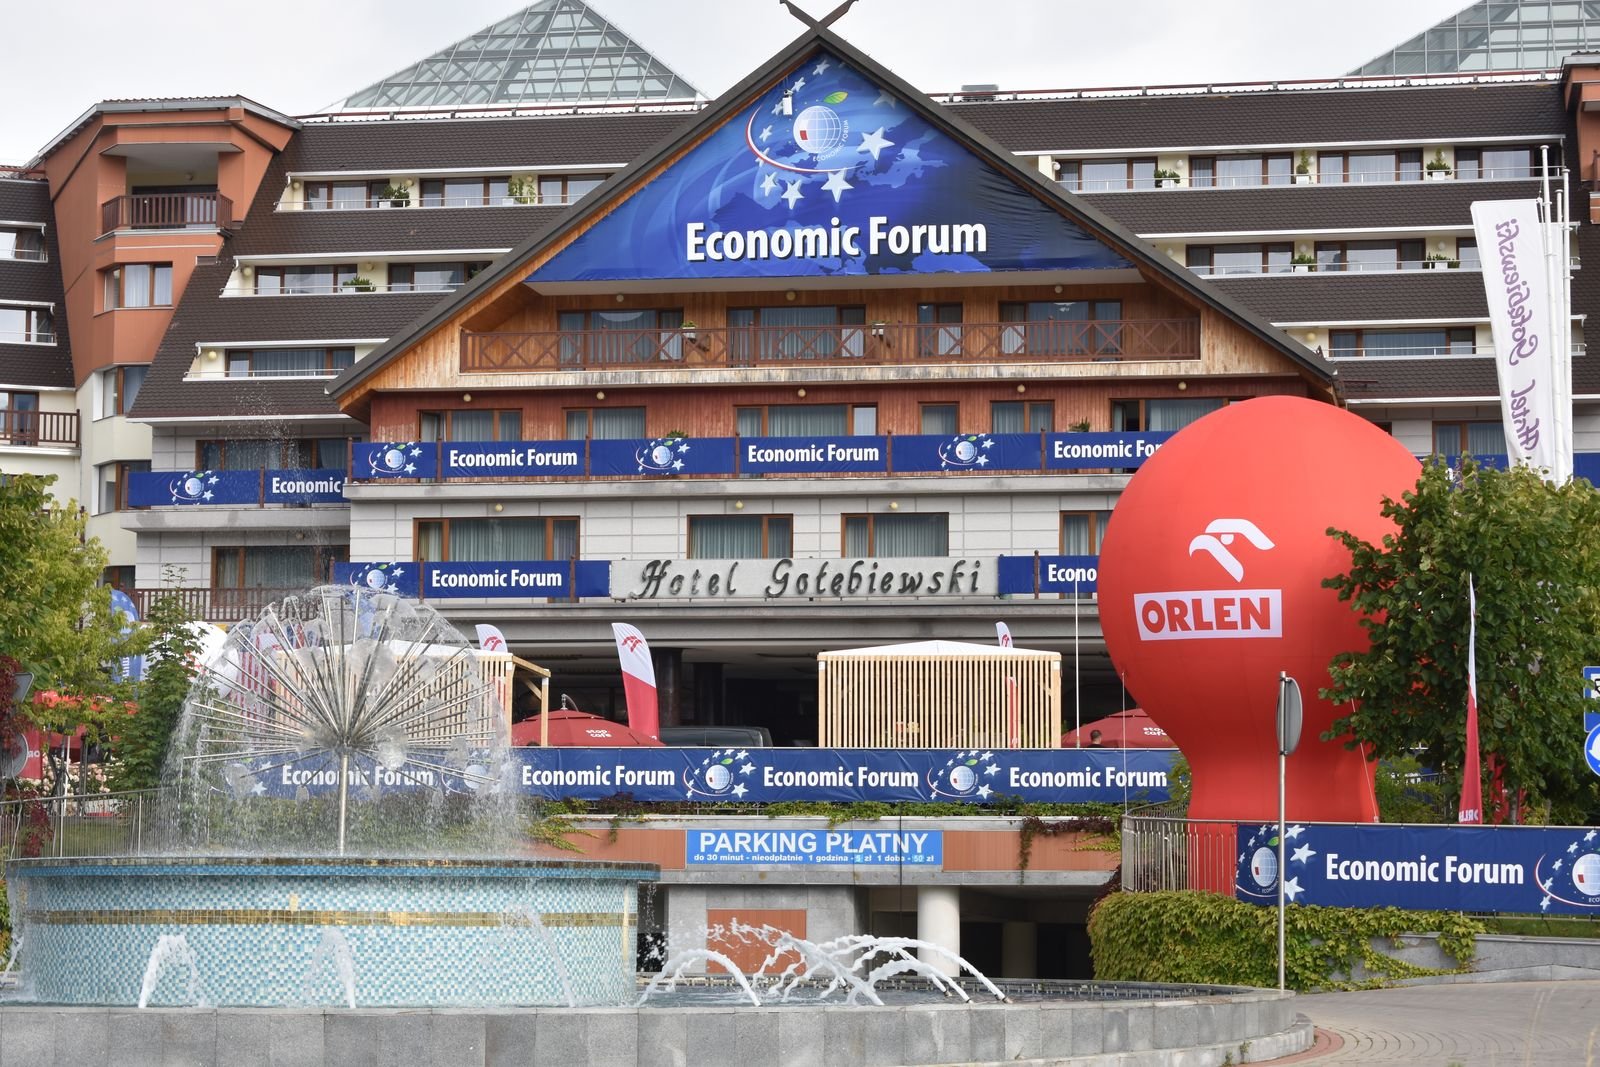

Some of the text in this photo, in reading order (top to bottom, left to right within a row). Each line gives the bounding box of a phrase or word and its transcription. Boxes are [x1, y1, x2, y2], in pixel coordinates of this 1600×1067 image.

[686, 216, 987, 261] Economic Forum
[449, 448, 578, 467] Economic Forum
[748, 444, 879, 463] Economic Forum
[1054, 439, 1133, 459] Economic
[272, 476, 341, 494] Economic
[432, 569, 562, 588] Economic Forum
[629, 559, 739, 600] Hotel
[1048, 563, 1098, 582] Econo
[1141, 597, 1271, 634] ORLEN
[374, 765, 434, 786] Forum
[522, 765, 675, 786] Economic Forum
[763, 766, 918, 787] Economic Forum
[1009, 766, 1167, 788] Economic Forum
[700, 832, 928, 853] PARKING PŁATNY
[752, 854, 803, 862] nieodpłatnie
[816, 855, 848, 863] godzina
[1326, 853, 1524, 885] Economic Forum
